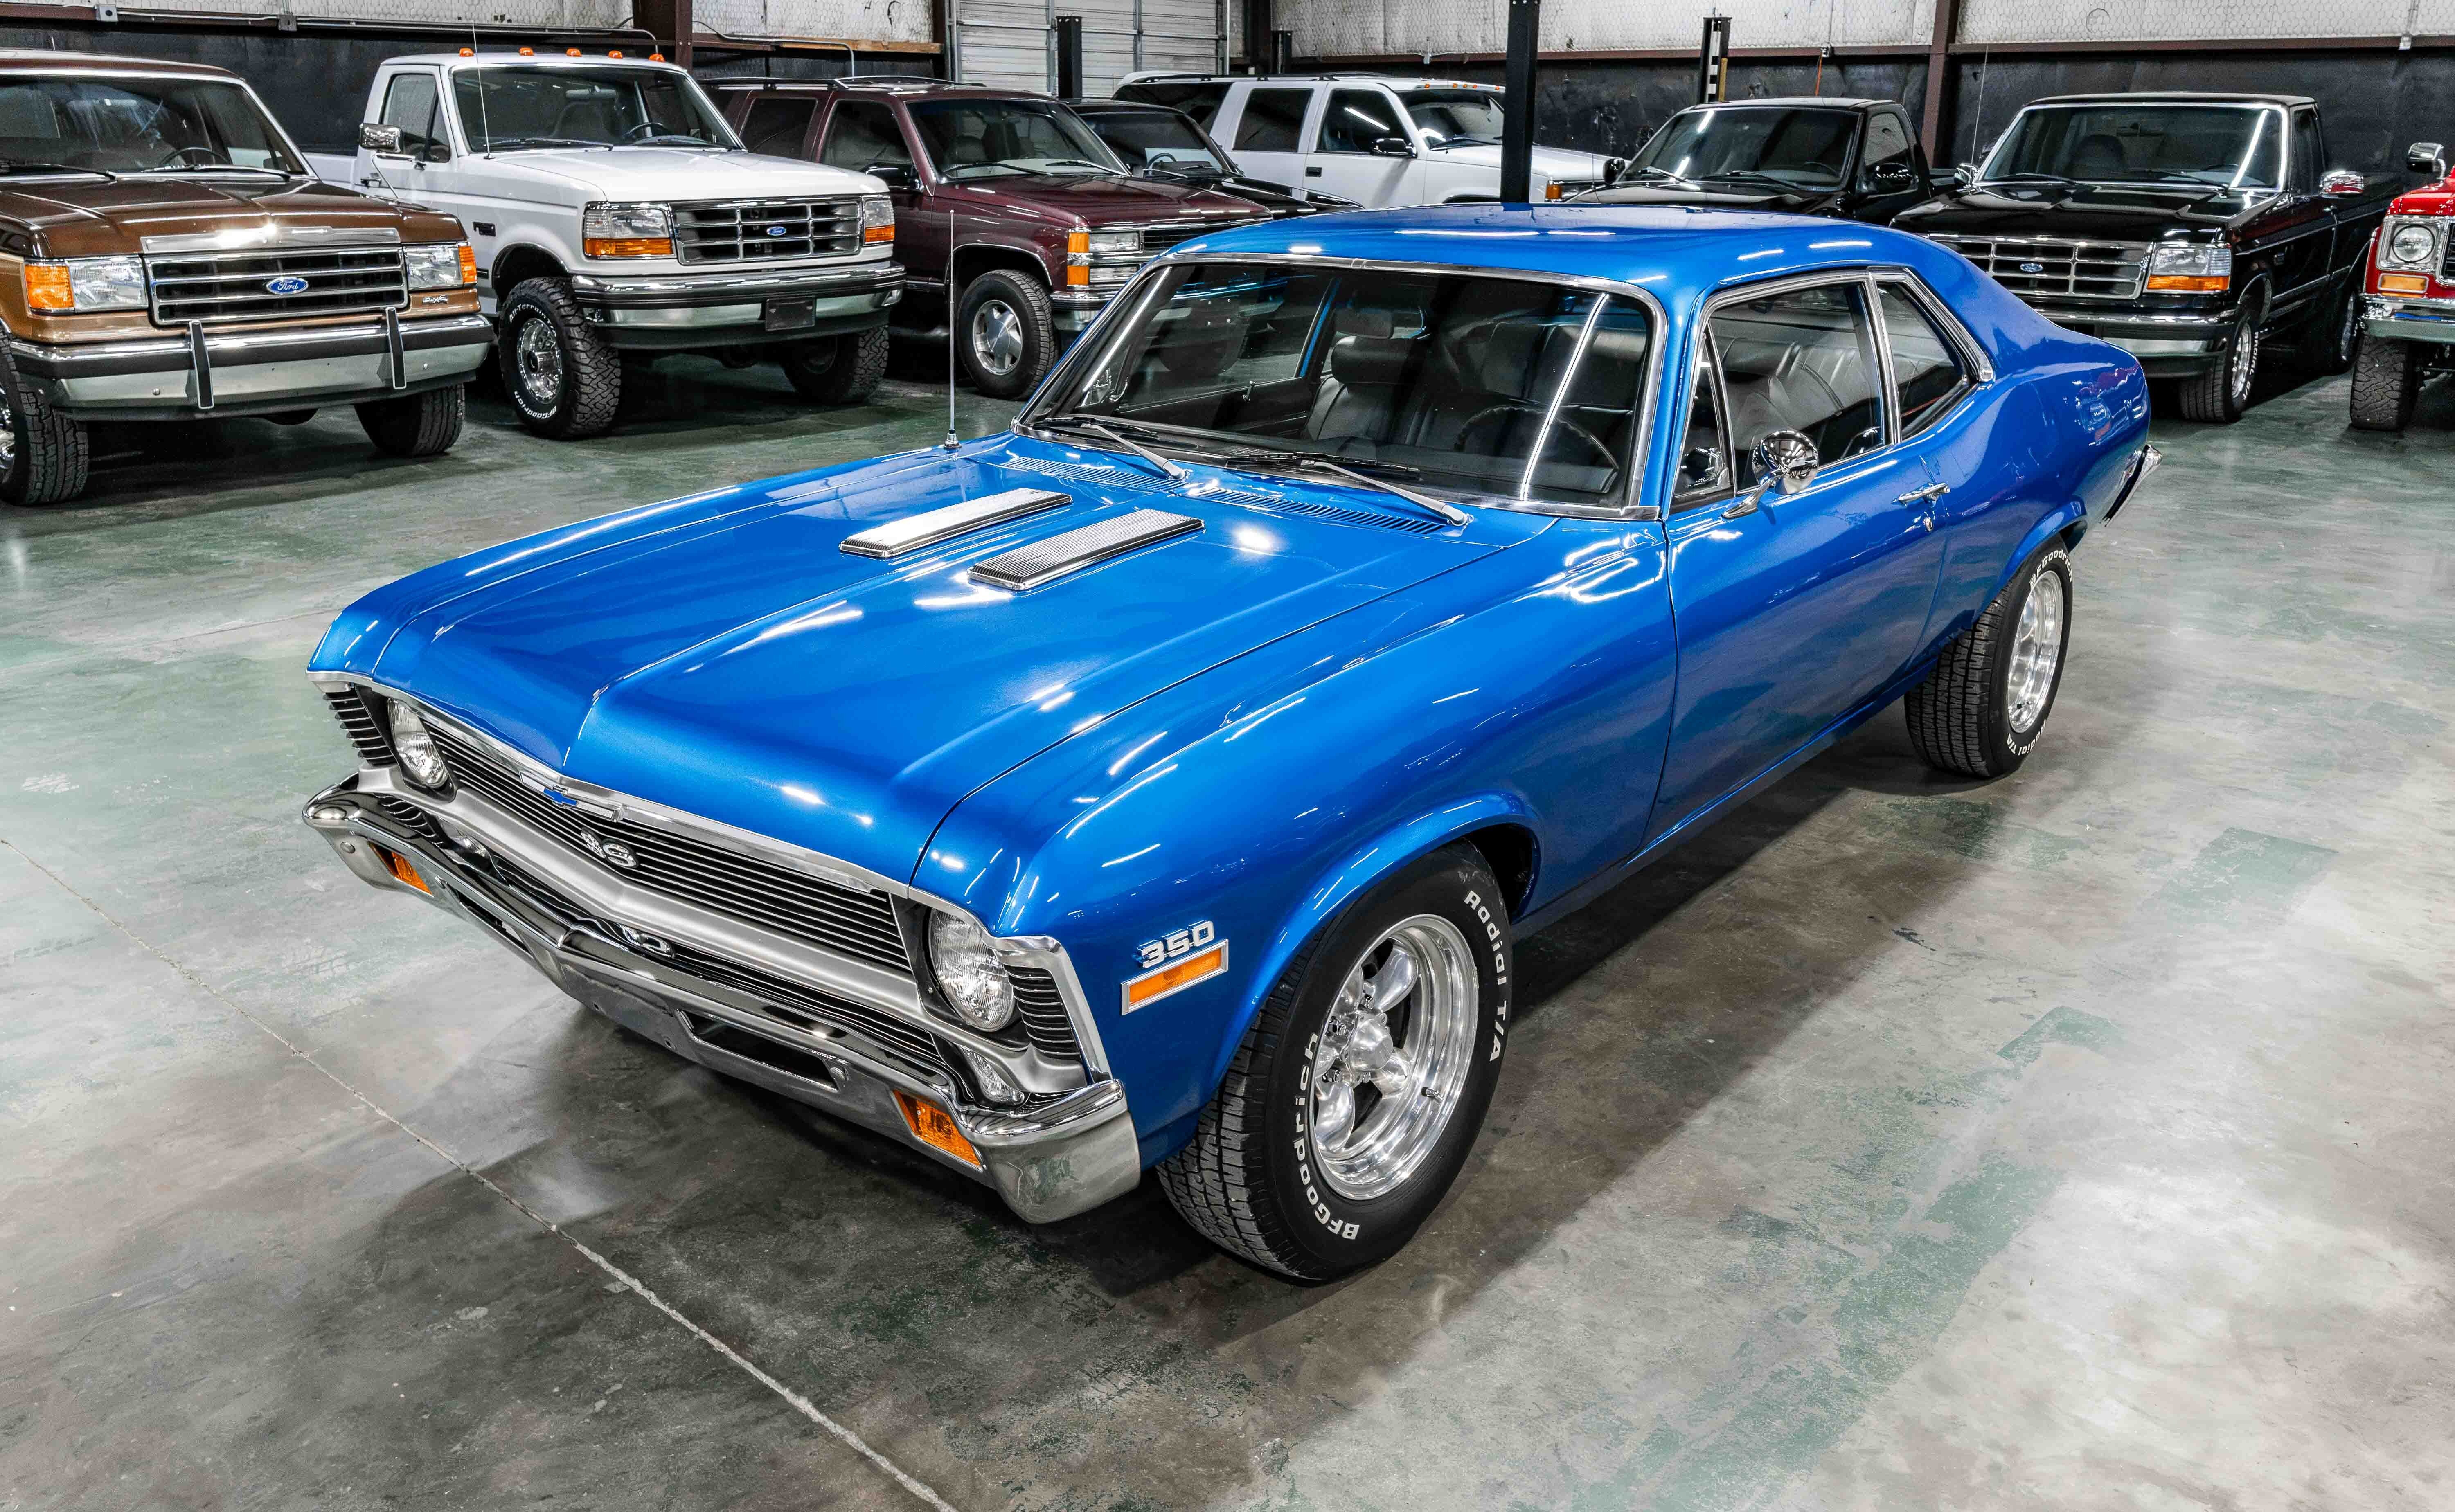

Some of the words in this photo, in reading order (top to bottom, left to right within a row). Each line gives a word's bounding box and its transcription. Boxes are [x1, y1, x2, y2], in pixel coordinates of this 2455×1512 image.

[277, 280, 299, 290] Ford
[509, 304, 546, 324] All-Terrain
[514, 391, 556, 419] BFGoodrich
[2029, 549, 2072, 590] BFGoodrich
[2007, 733, 2017, 754] T/A
[1137, 920, 1215, 969] 350
[1464, 890, 1507, 985] Radial
[1489, 1000, 1507, 1062] T/A
[1293, 1033, 1360, 1240] BFGoodrich
